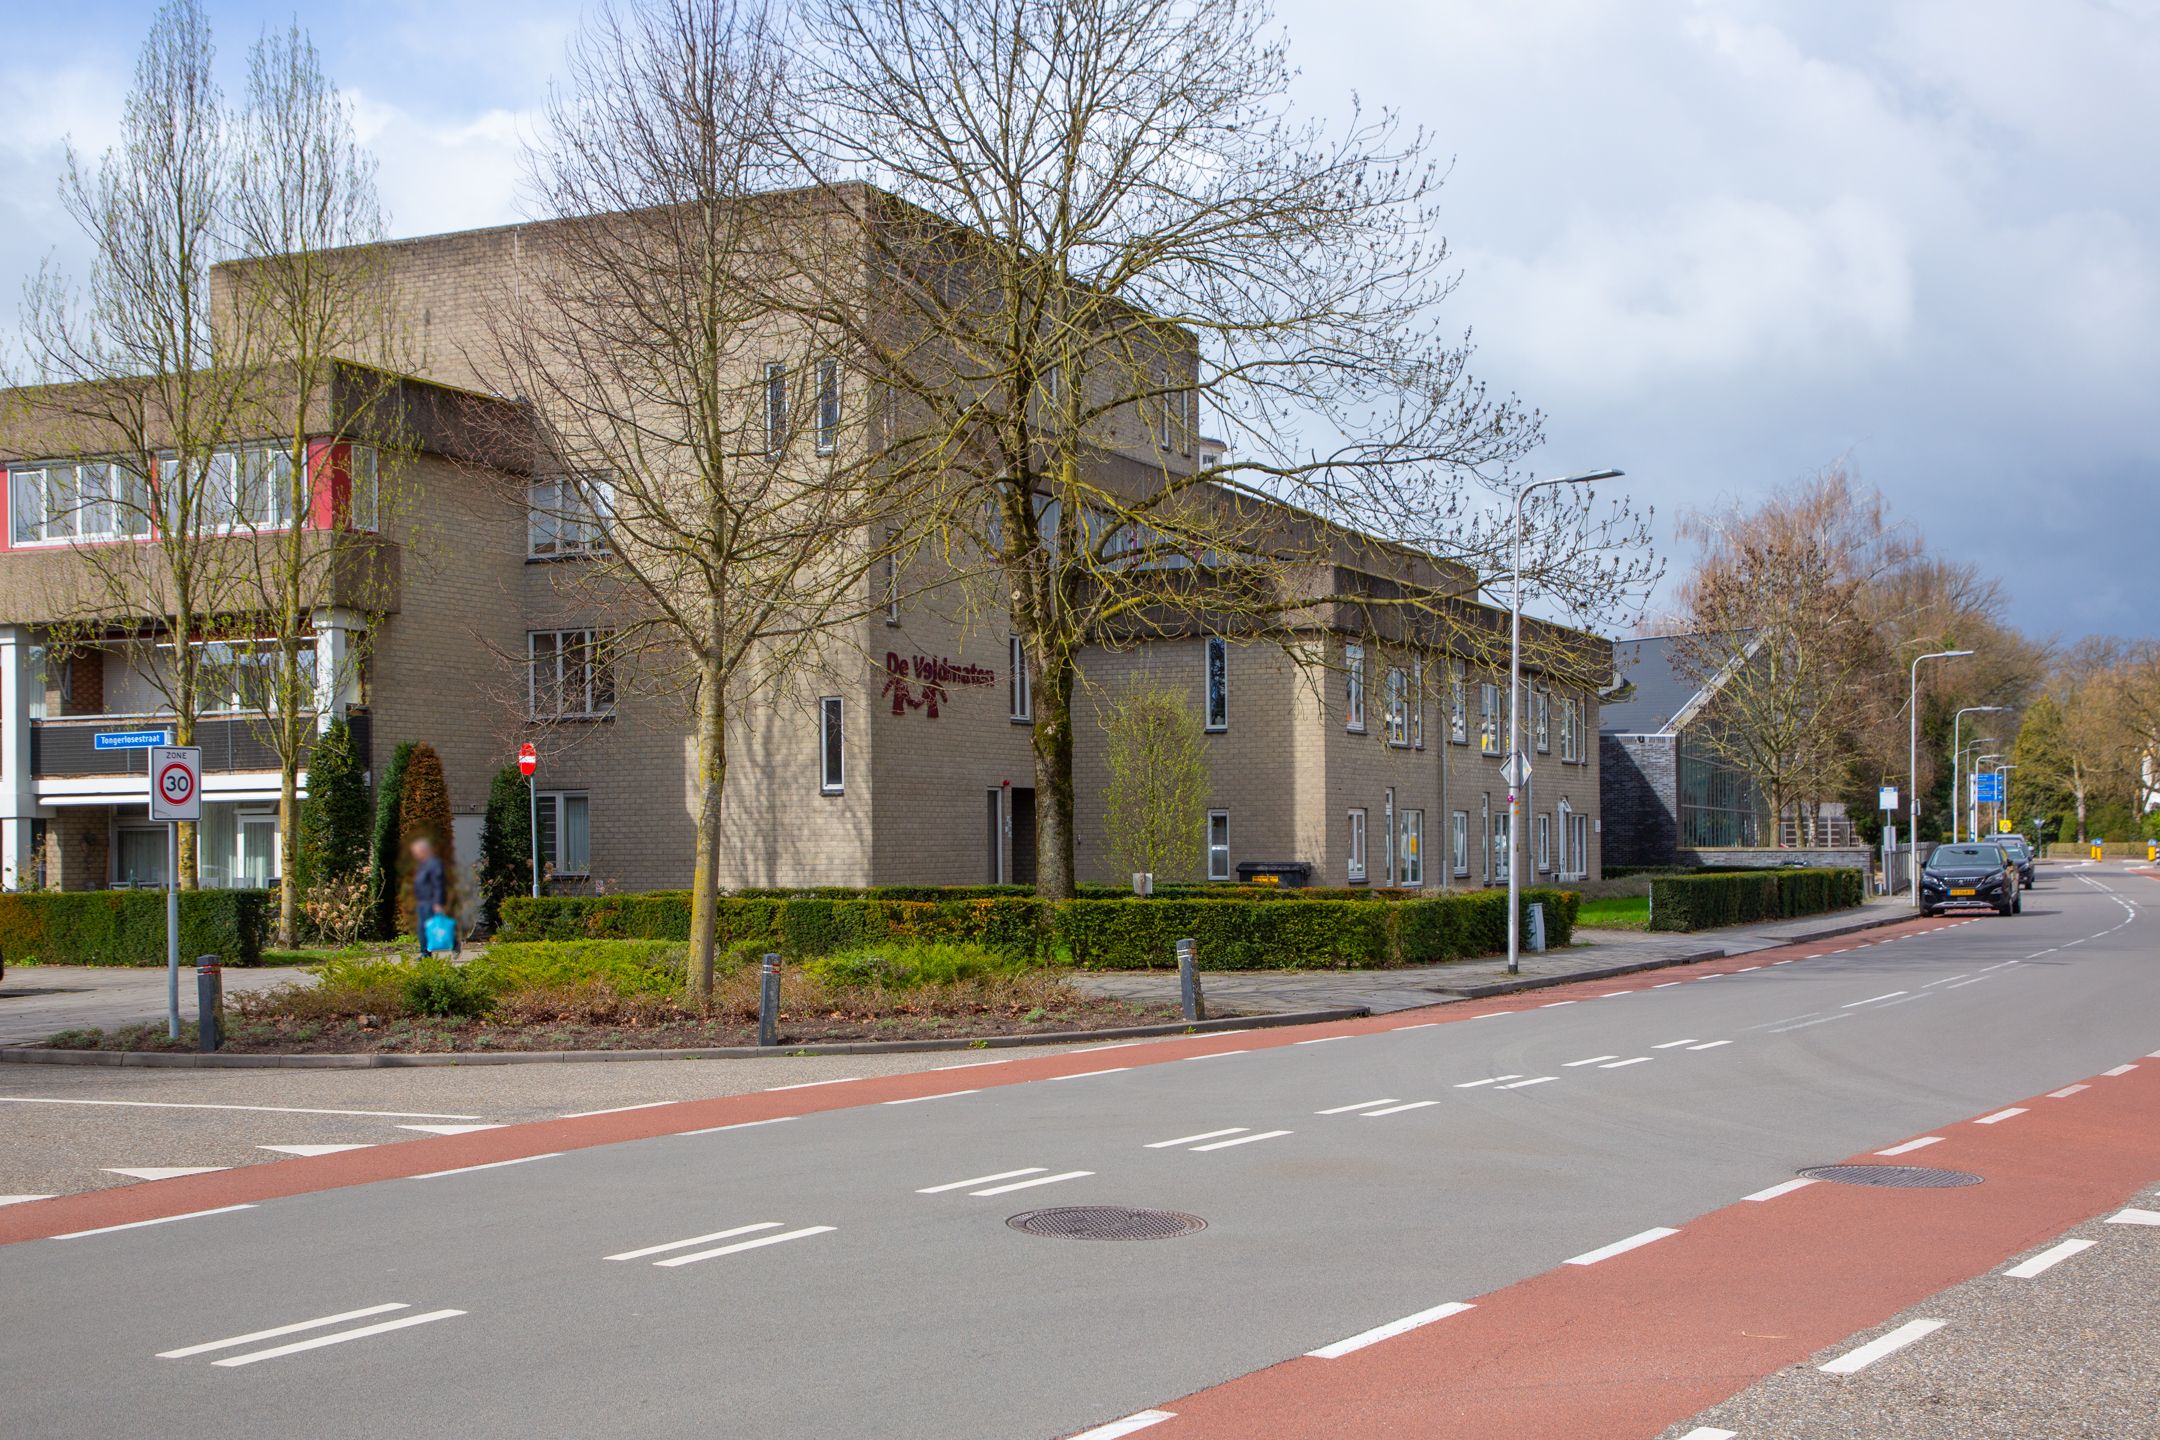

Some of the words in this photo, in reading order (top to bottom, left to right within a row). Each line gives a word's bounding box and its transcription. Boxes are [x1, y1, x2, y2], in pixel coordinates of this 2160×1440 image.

[886, 651, 909, 677] De
[100, 734, 160, 746] Tongerlosestraat
[165, 776, 189, 792] 30
